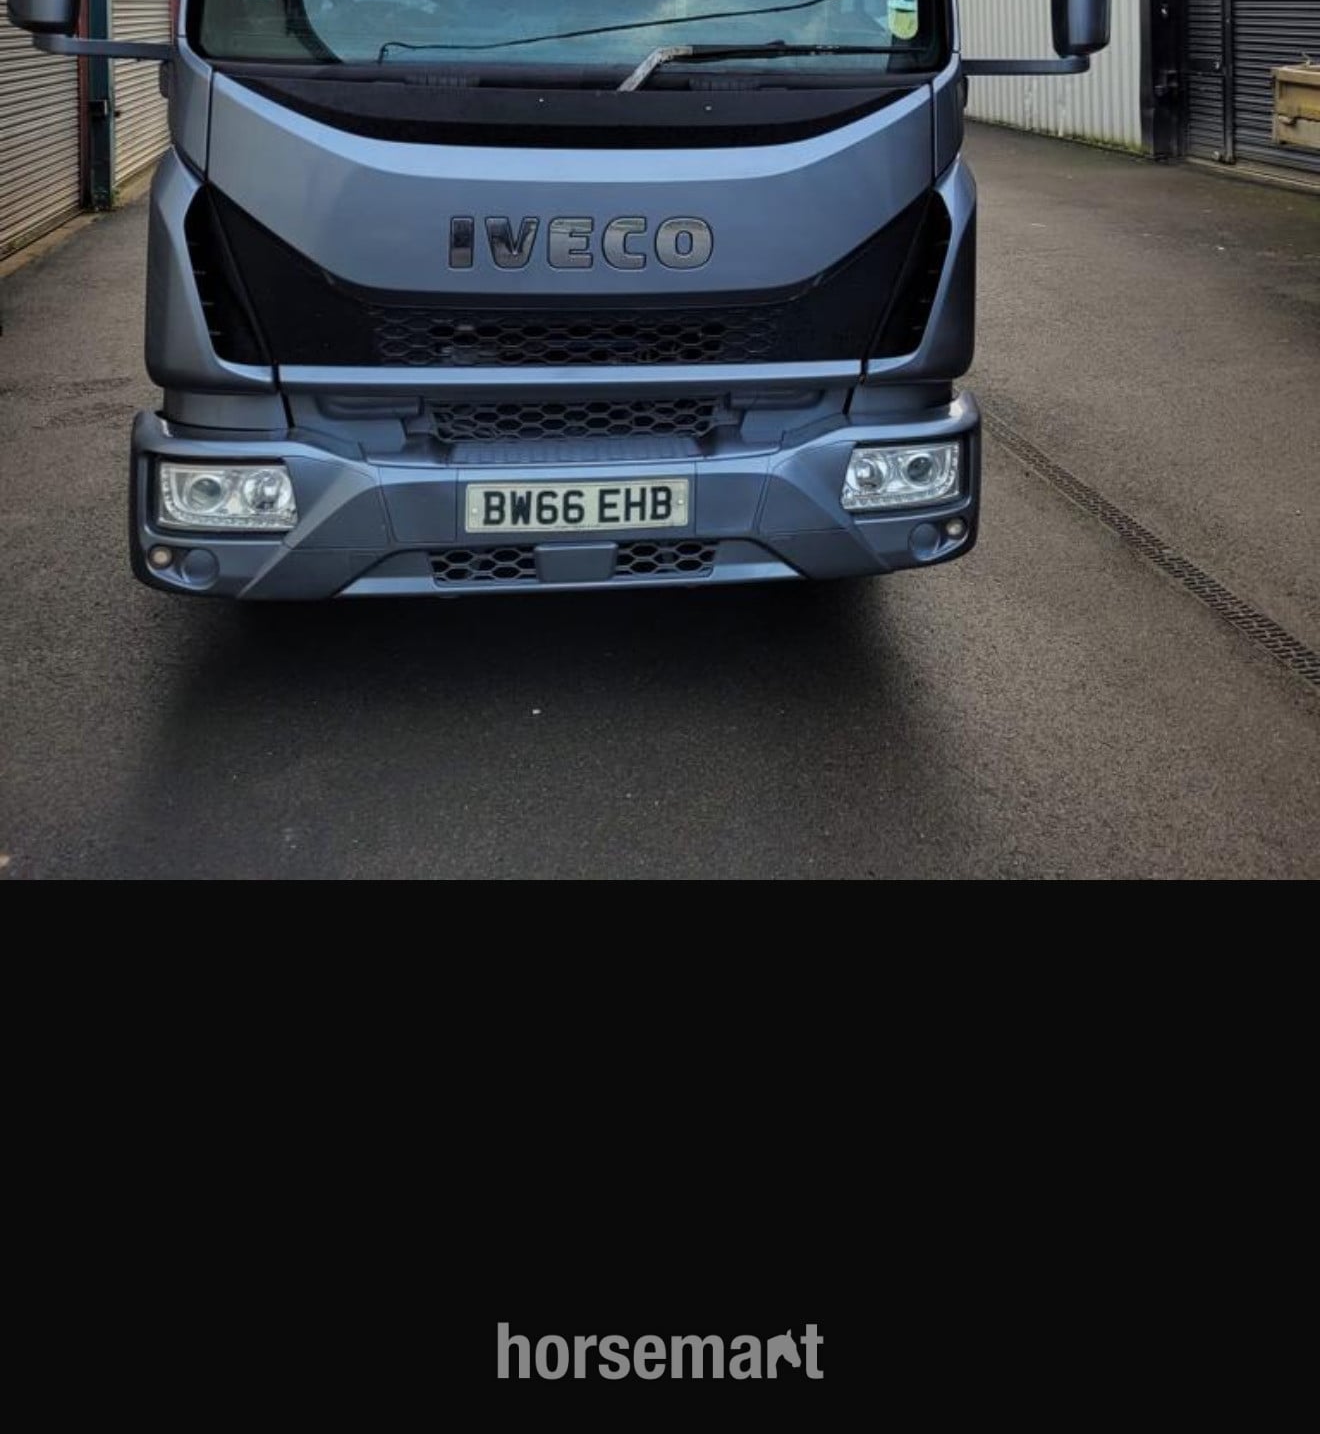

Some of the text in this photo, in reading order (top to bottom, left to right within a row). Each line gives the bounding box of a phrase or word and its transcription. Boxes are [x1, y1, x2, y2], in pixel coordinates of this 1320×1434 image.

[447, 215, 715, 272] IVECO
[482, 485, 673, 526] BW66 EHB
